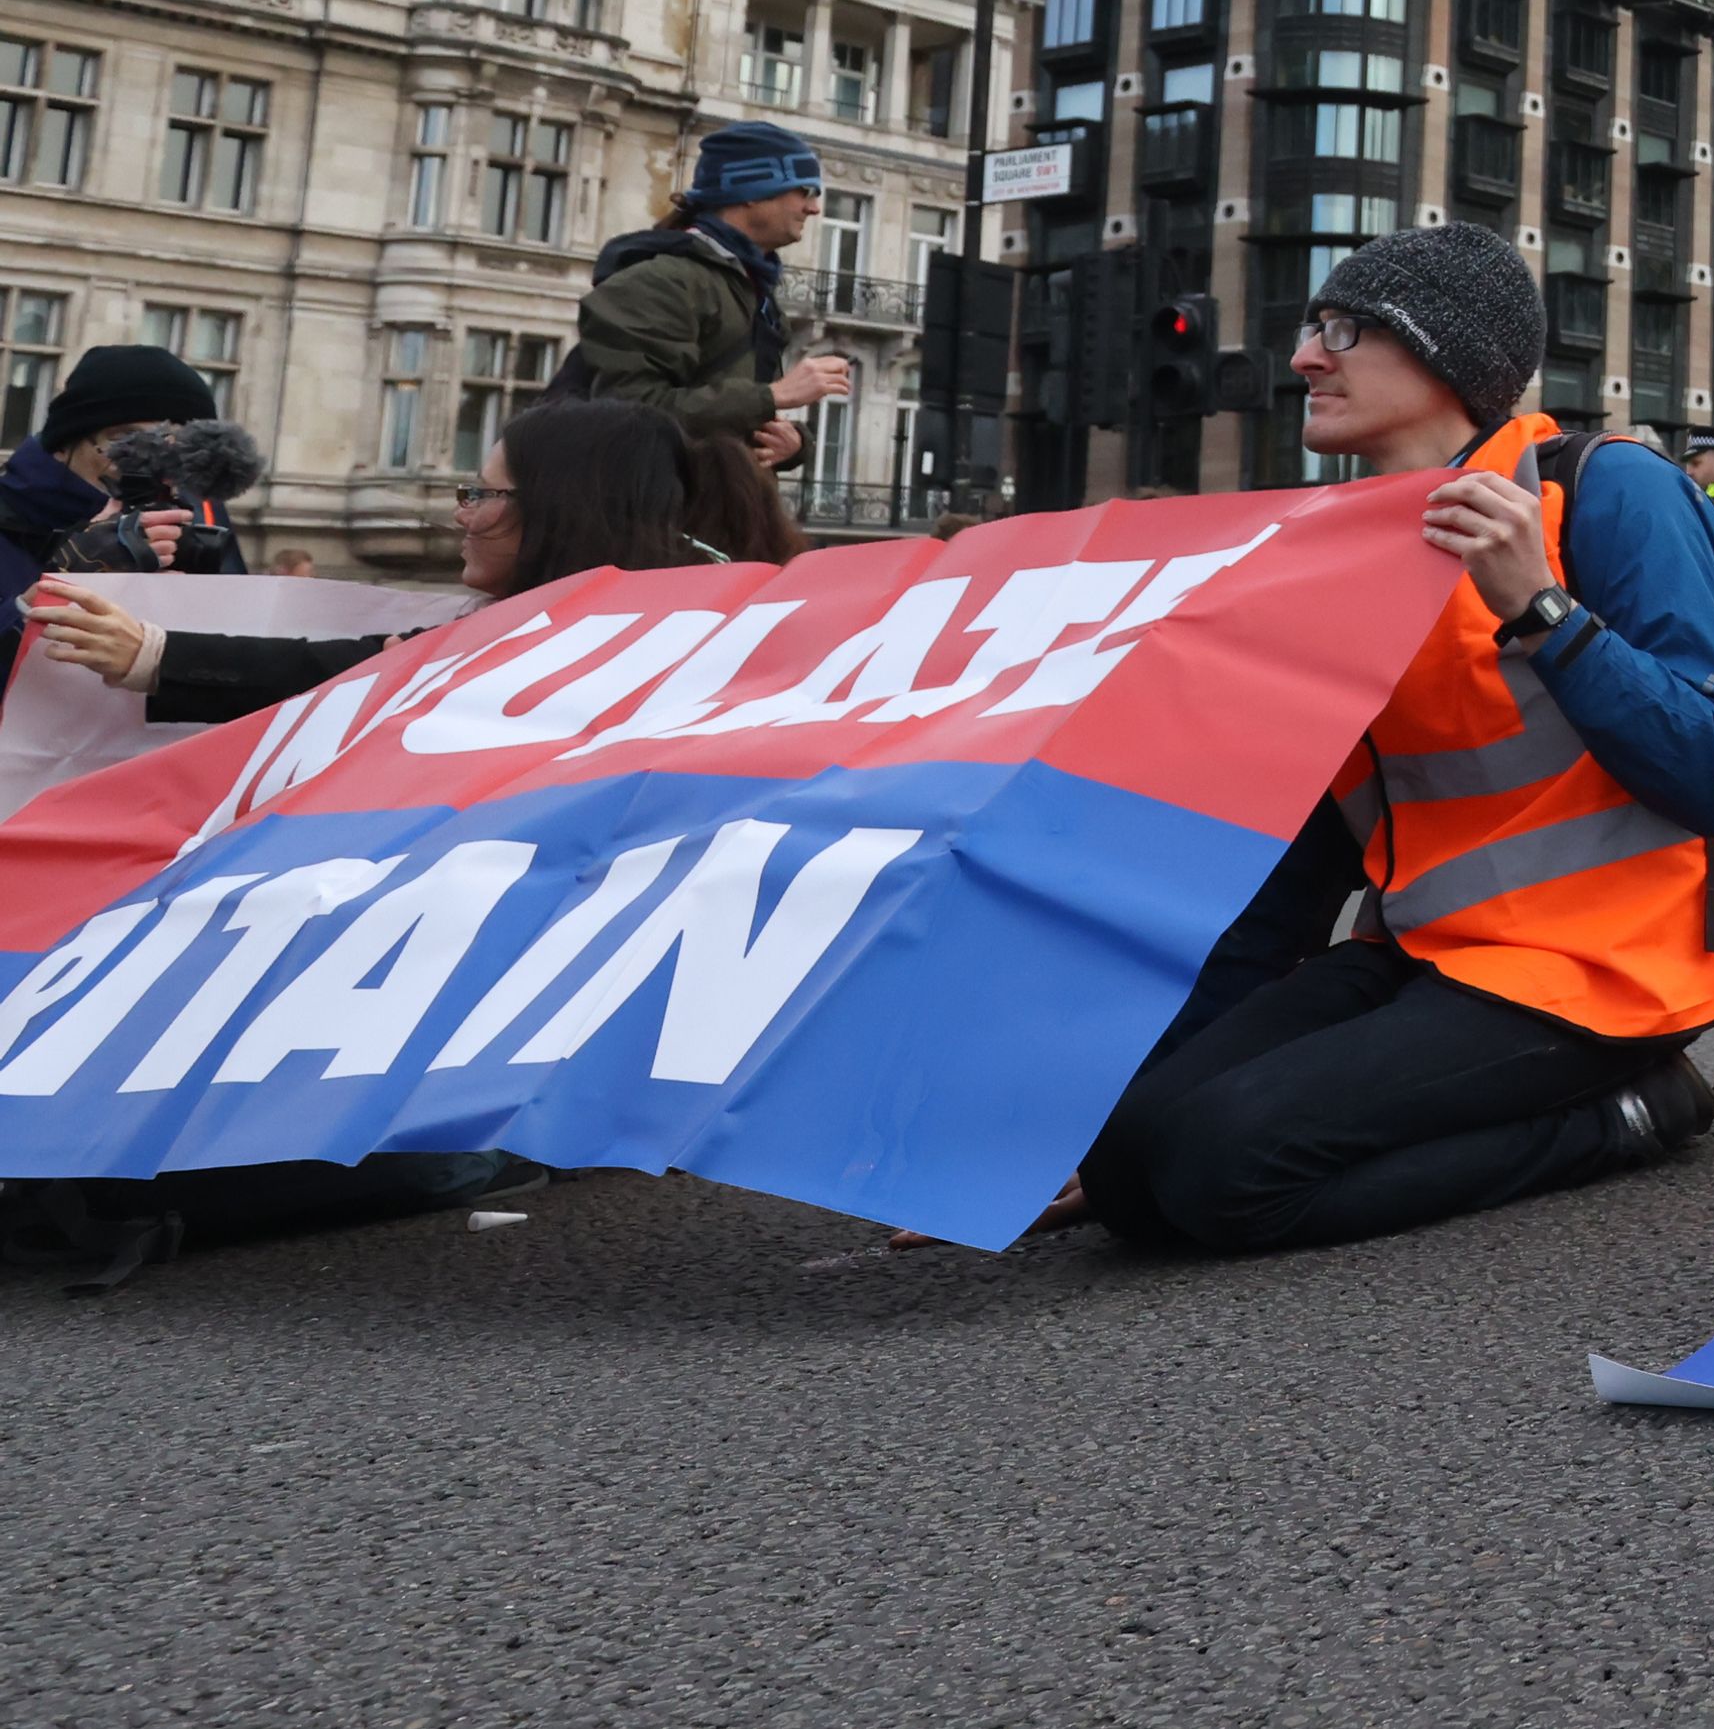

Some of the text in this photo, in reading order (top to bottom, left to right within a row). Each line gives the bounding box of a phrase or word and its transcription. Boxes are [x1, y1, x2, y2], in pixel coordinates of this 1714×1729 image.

[993, 150, 1057, 168] PARLIAMENT
[992, 167, 1032, 183] SQUARE
[1393, 308, 1439, 352] Columbia
[160, 523, 1281, 873] INULATE
